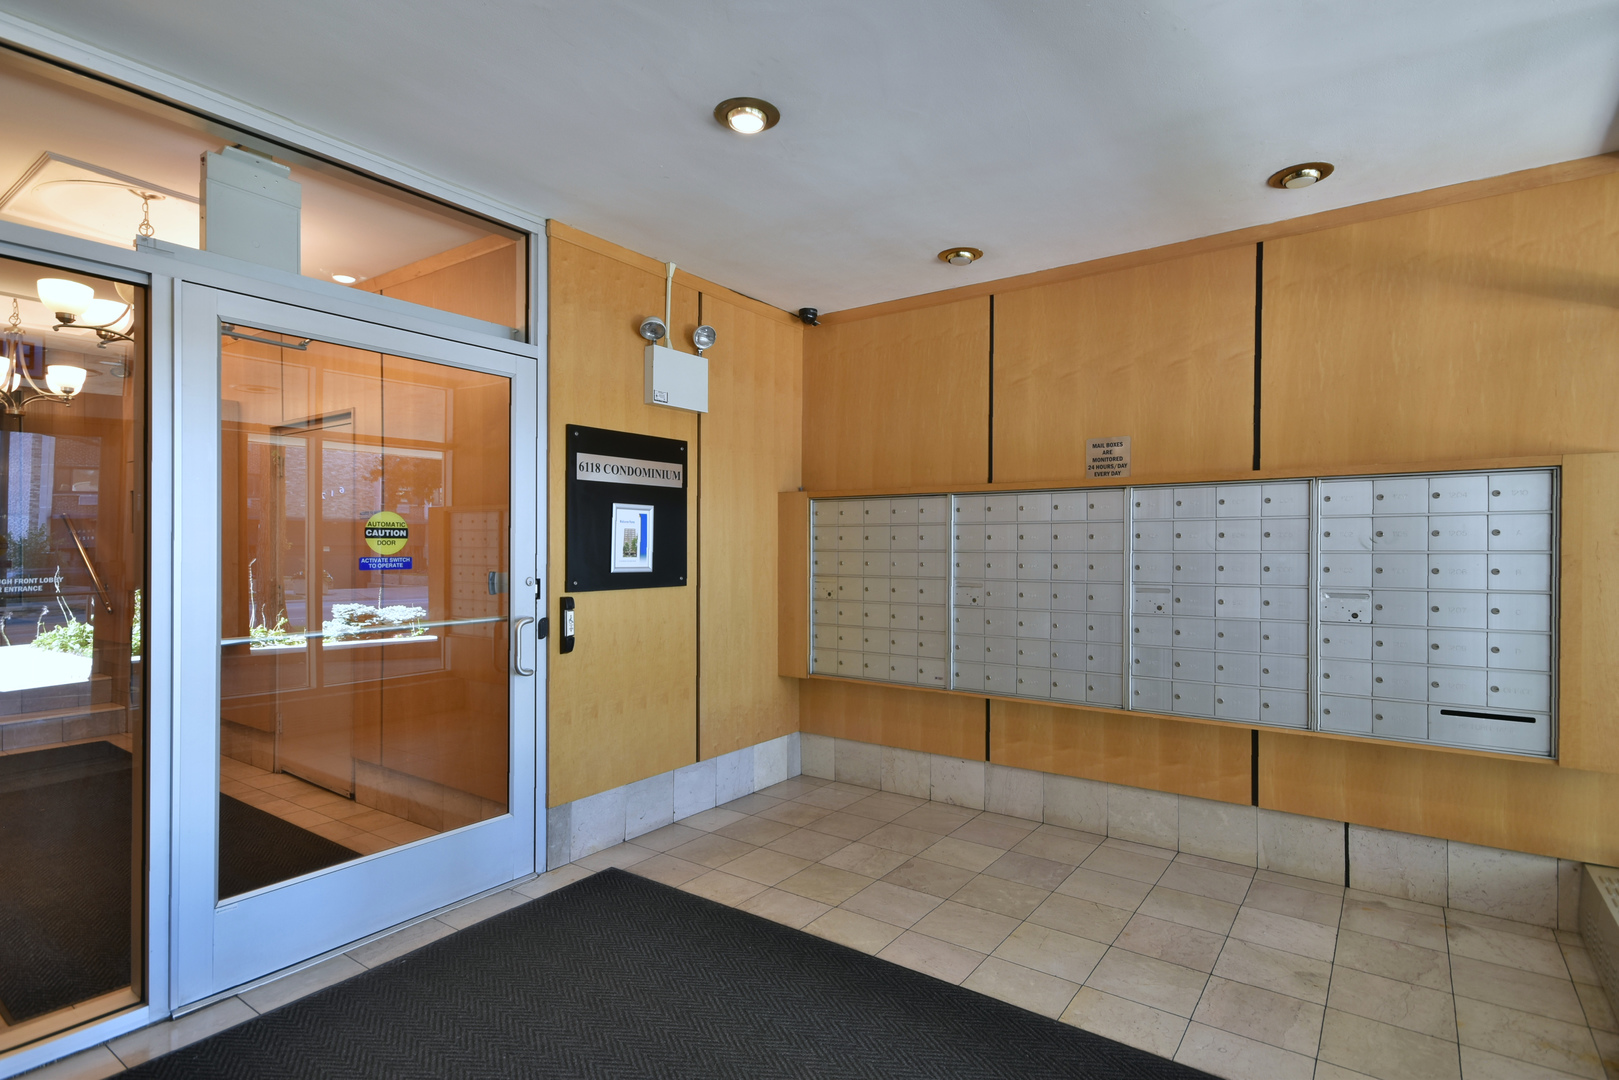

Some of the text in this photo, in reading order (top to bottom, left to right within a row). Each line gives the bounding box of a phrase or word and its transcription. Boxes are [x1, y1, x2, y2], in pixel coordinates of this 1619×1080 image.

[578, 461, 681, 481] 6118 CONDOMINIUM
[365, 529, 407, 537] CAUTION
[4, 585, 43, 593] ENTRANCE
